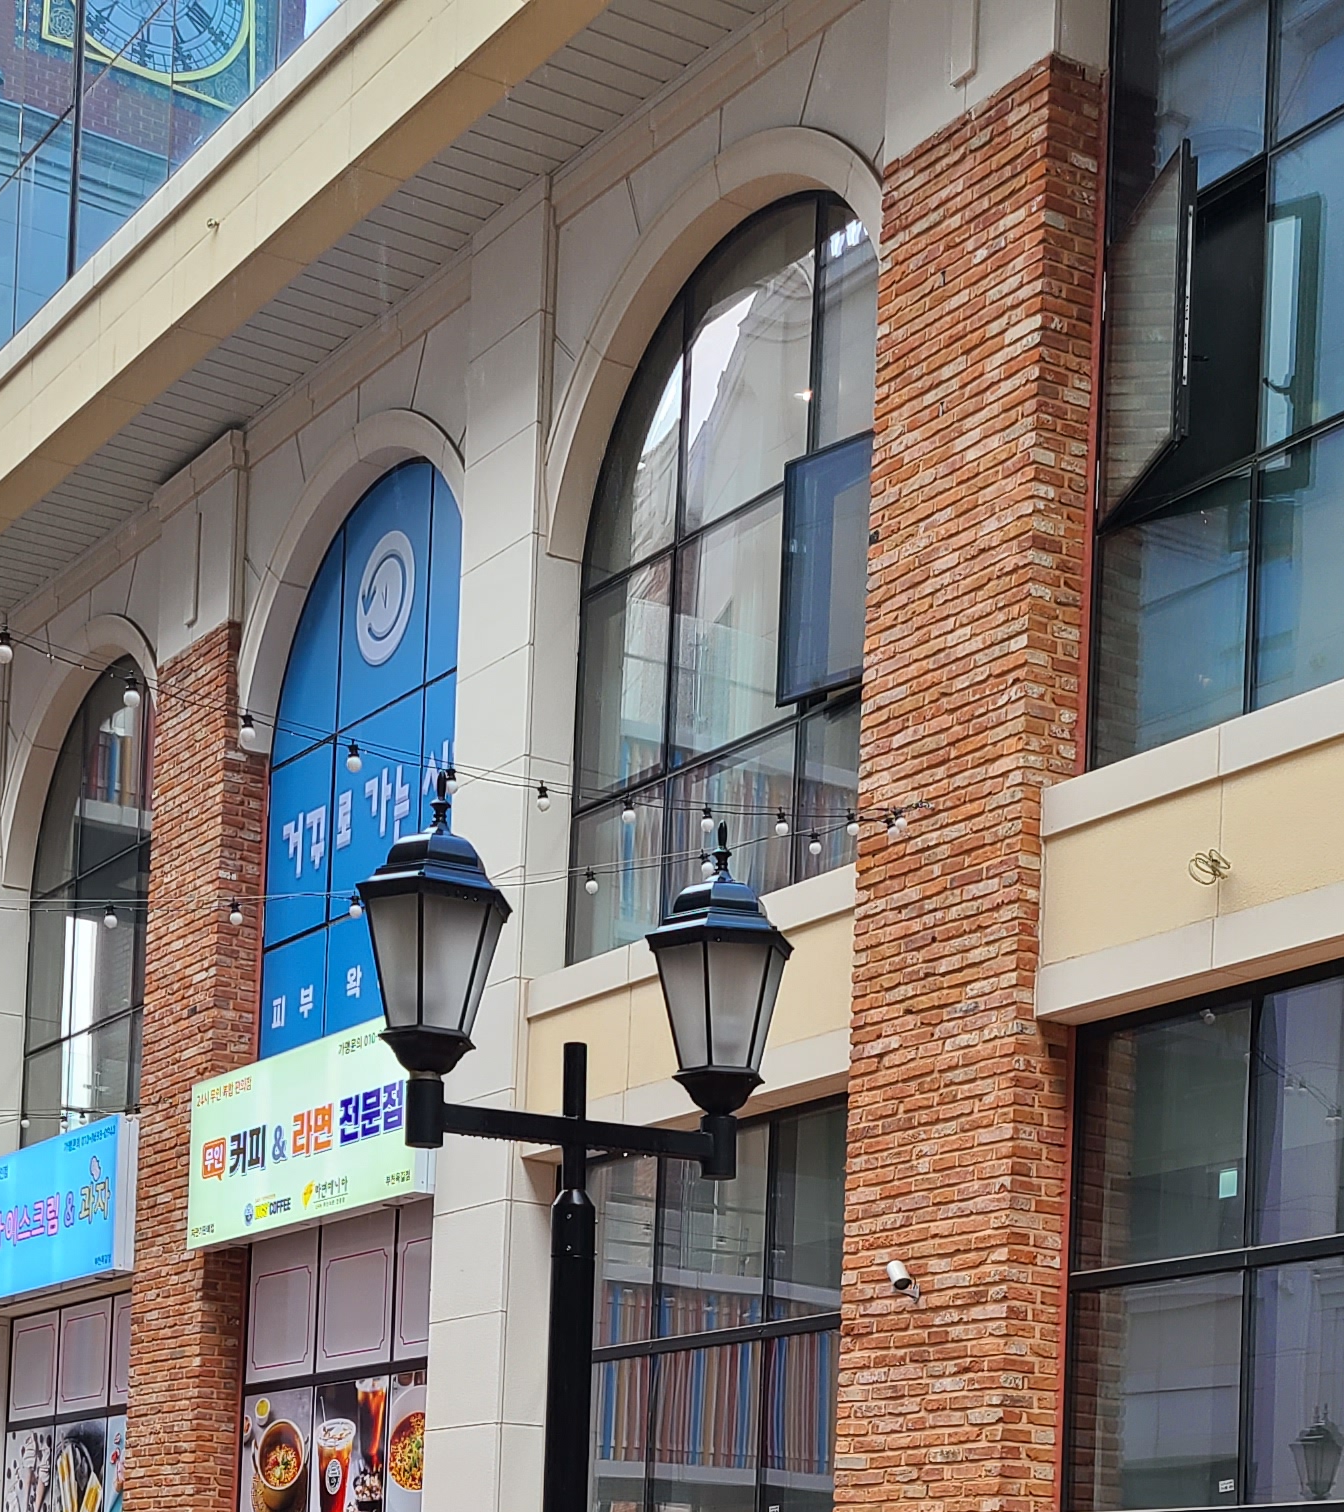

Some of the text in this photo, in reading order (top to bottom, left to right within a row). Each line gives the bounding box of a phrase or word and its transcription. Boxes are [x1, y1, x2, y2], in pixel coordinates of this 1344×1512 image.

[282, 737, 455, 880] 거꾸로 가는 시
[271, 984, 314, 1029] 피부
[204, 1079, 405, 1176] 무인 커피 & 라면 전문점
[63, 1190, 76, 1228] &
[78, 1175, 111, 1225] 과자
[269, 1196, 291, 1216] COFFEE
